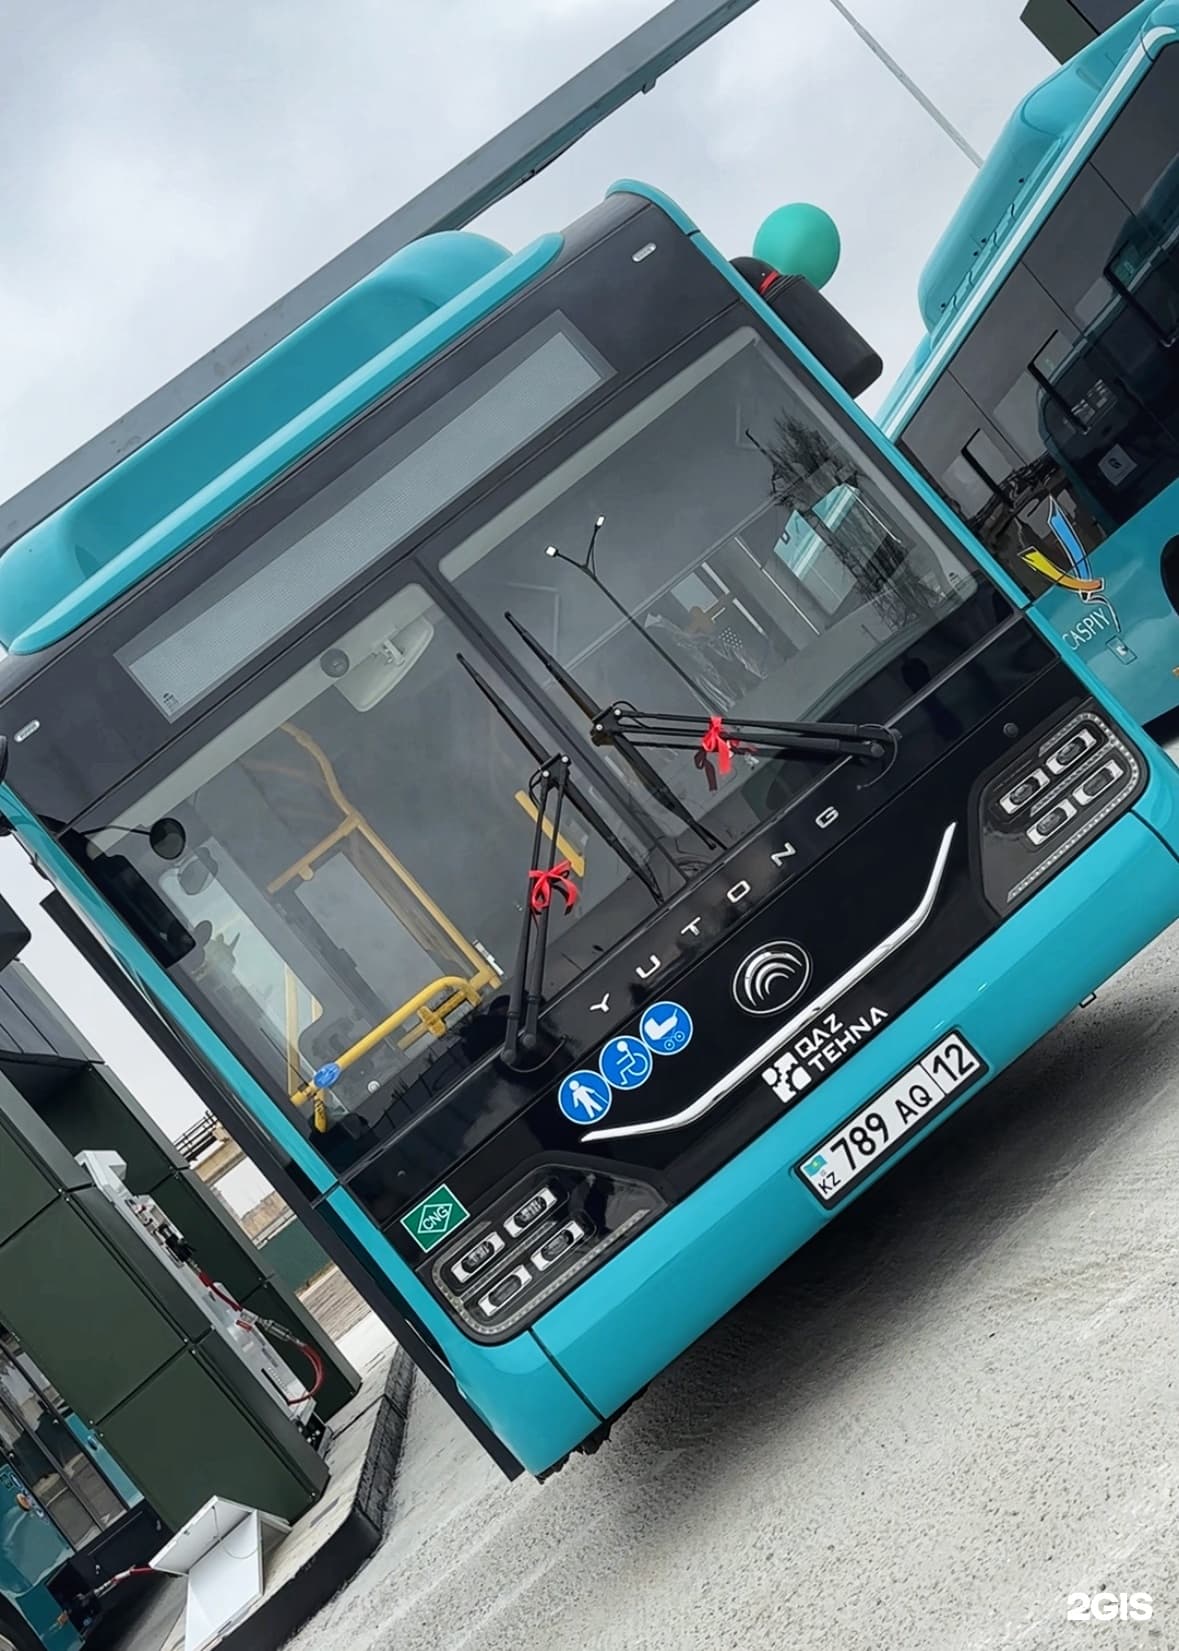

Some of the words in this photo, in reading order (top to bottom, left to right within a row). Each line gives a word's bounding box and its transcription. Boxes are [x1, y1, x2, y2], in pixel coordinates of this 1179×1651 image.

[1062, 607, 1110, 650] CASPIY
[590, 806, 839, 1013] YUTONG
[794, 1013, 843, 1058] QAZ
[807, 1007, 889, 1071] TEHNA
[830, 1112, 889, 1170] 789
[895, 1084, 933, 1124] AQ
[933, 1043, 975, 1082] 12
[818, 1171, 842, 1194] KZ
[423, 1206, 449, 1230] CNG
